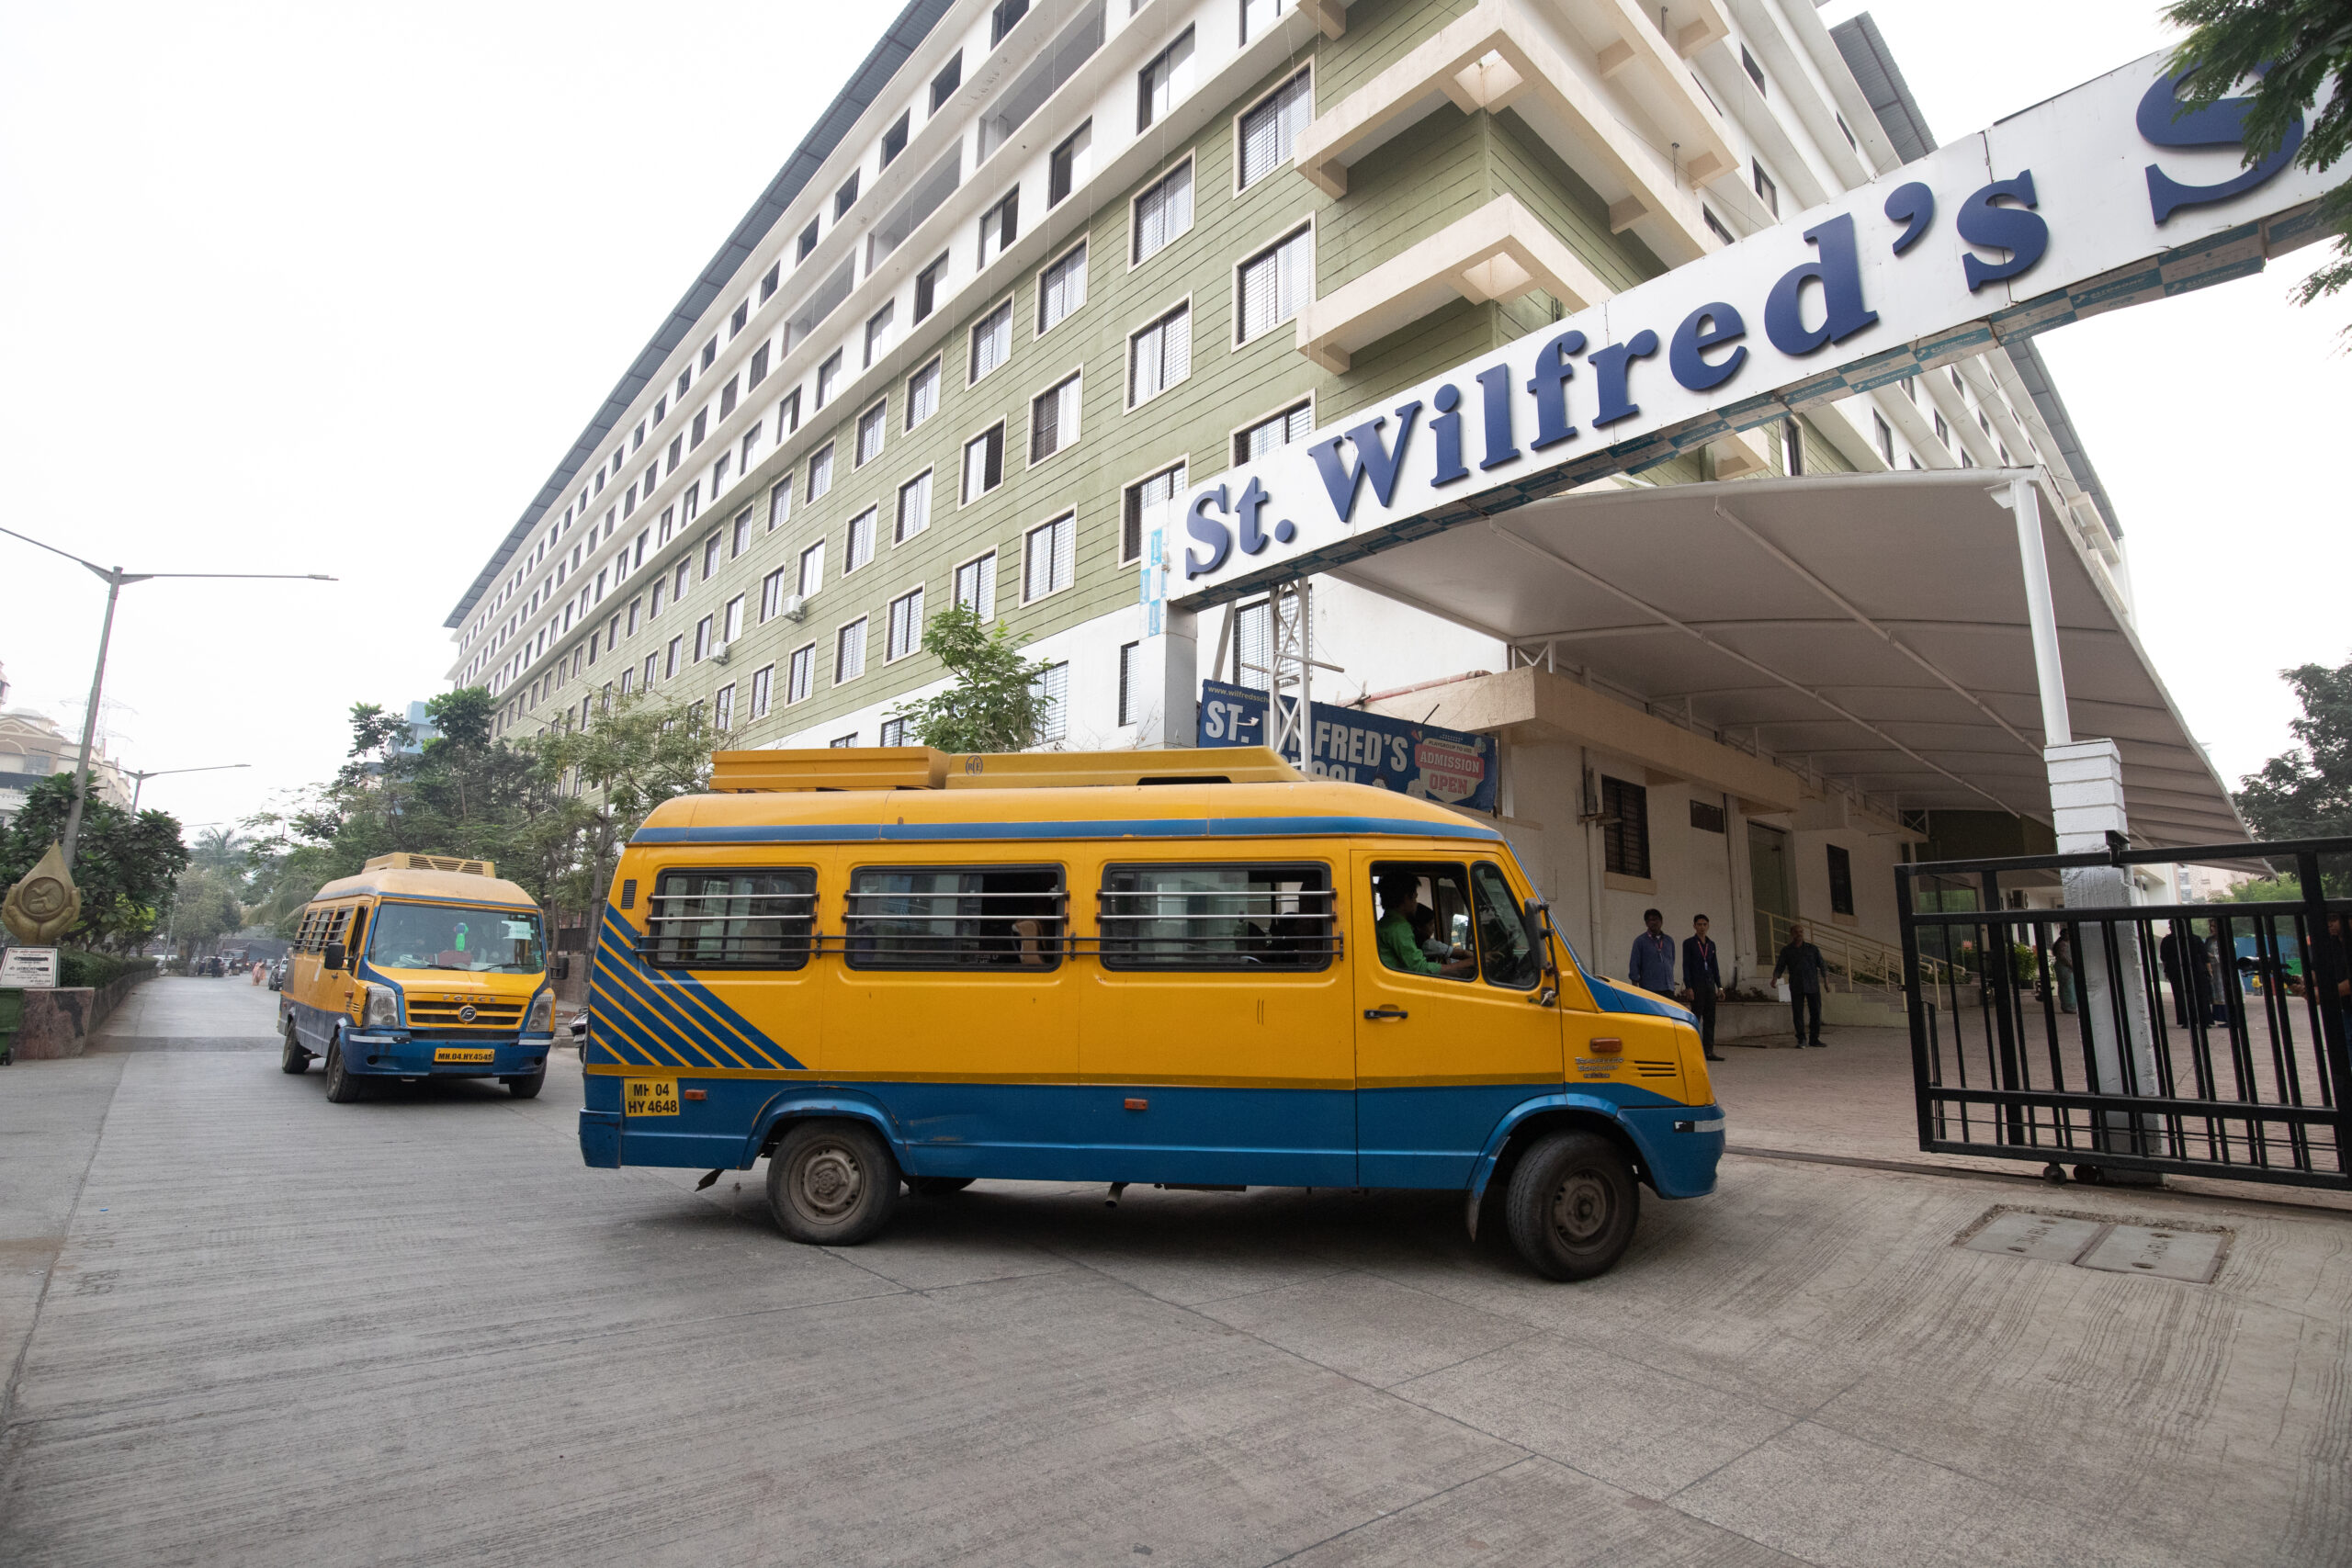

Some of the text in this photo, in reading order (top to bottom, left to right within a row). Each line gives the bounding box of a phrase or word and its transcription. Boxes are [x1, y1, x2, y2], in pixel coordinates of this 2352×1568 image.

[1185, 476, 1296, 581] St.
[1307, 168, 2050, 524] Wilfred's
[1205, 701, 1250, 744] ST.
[1419, 751, 1480, 773] ADMISSION
[1429, 773, 1468, 795] OPEN
[443, 994, 496, 1003] FORCE
[655, 1083, 670, 1097] 04
[628, 1100, 677, 1113] HY 4648
